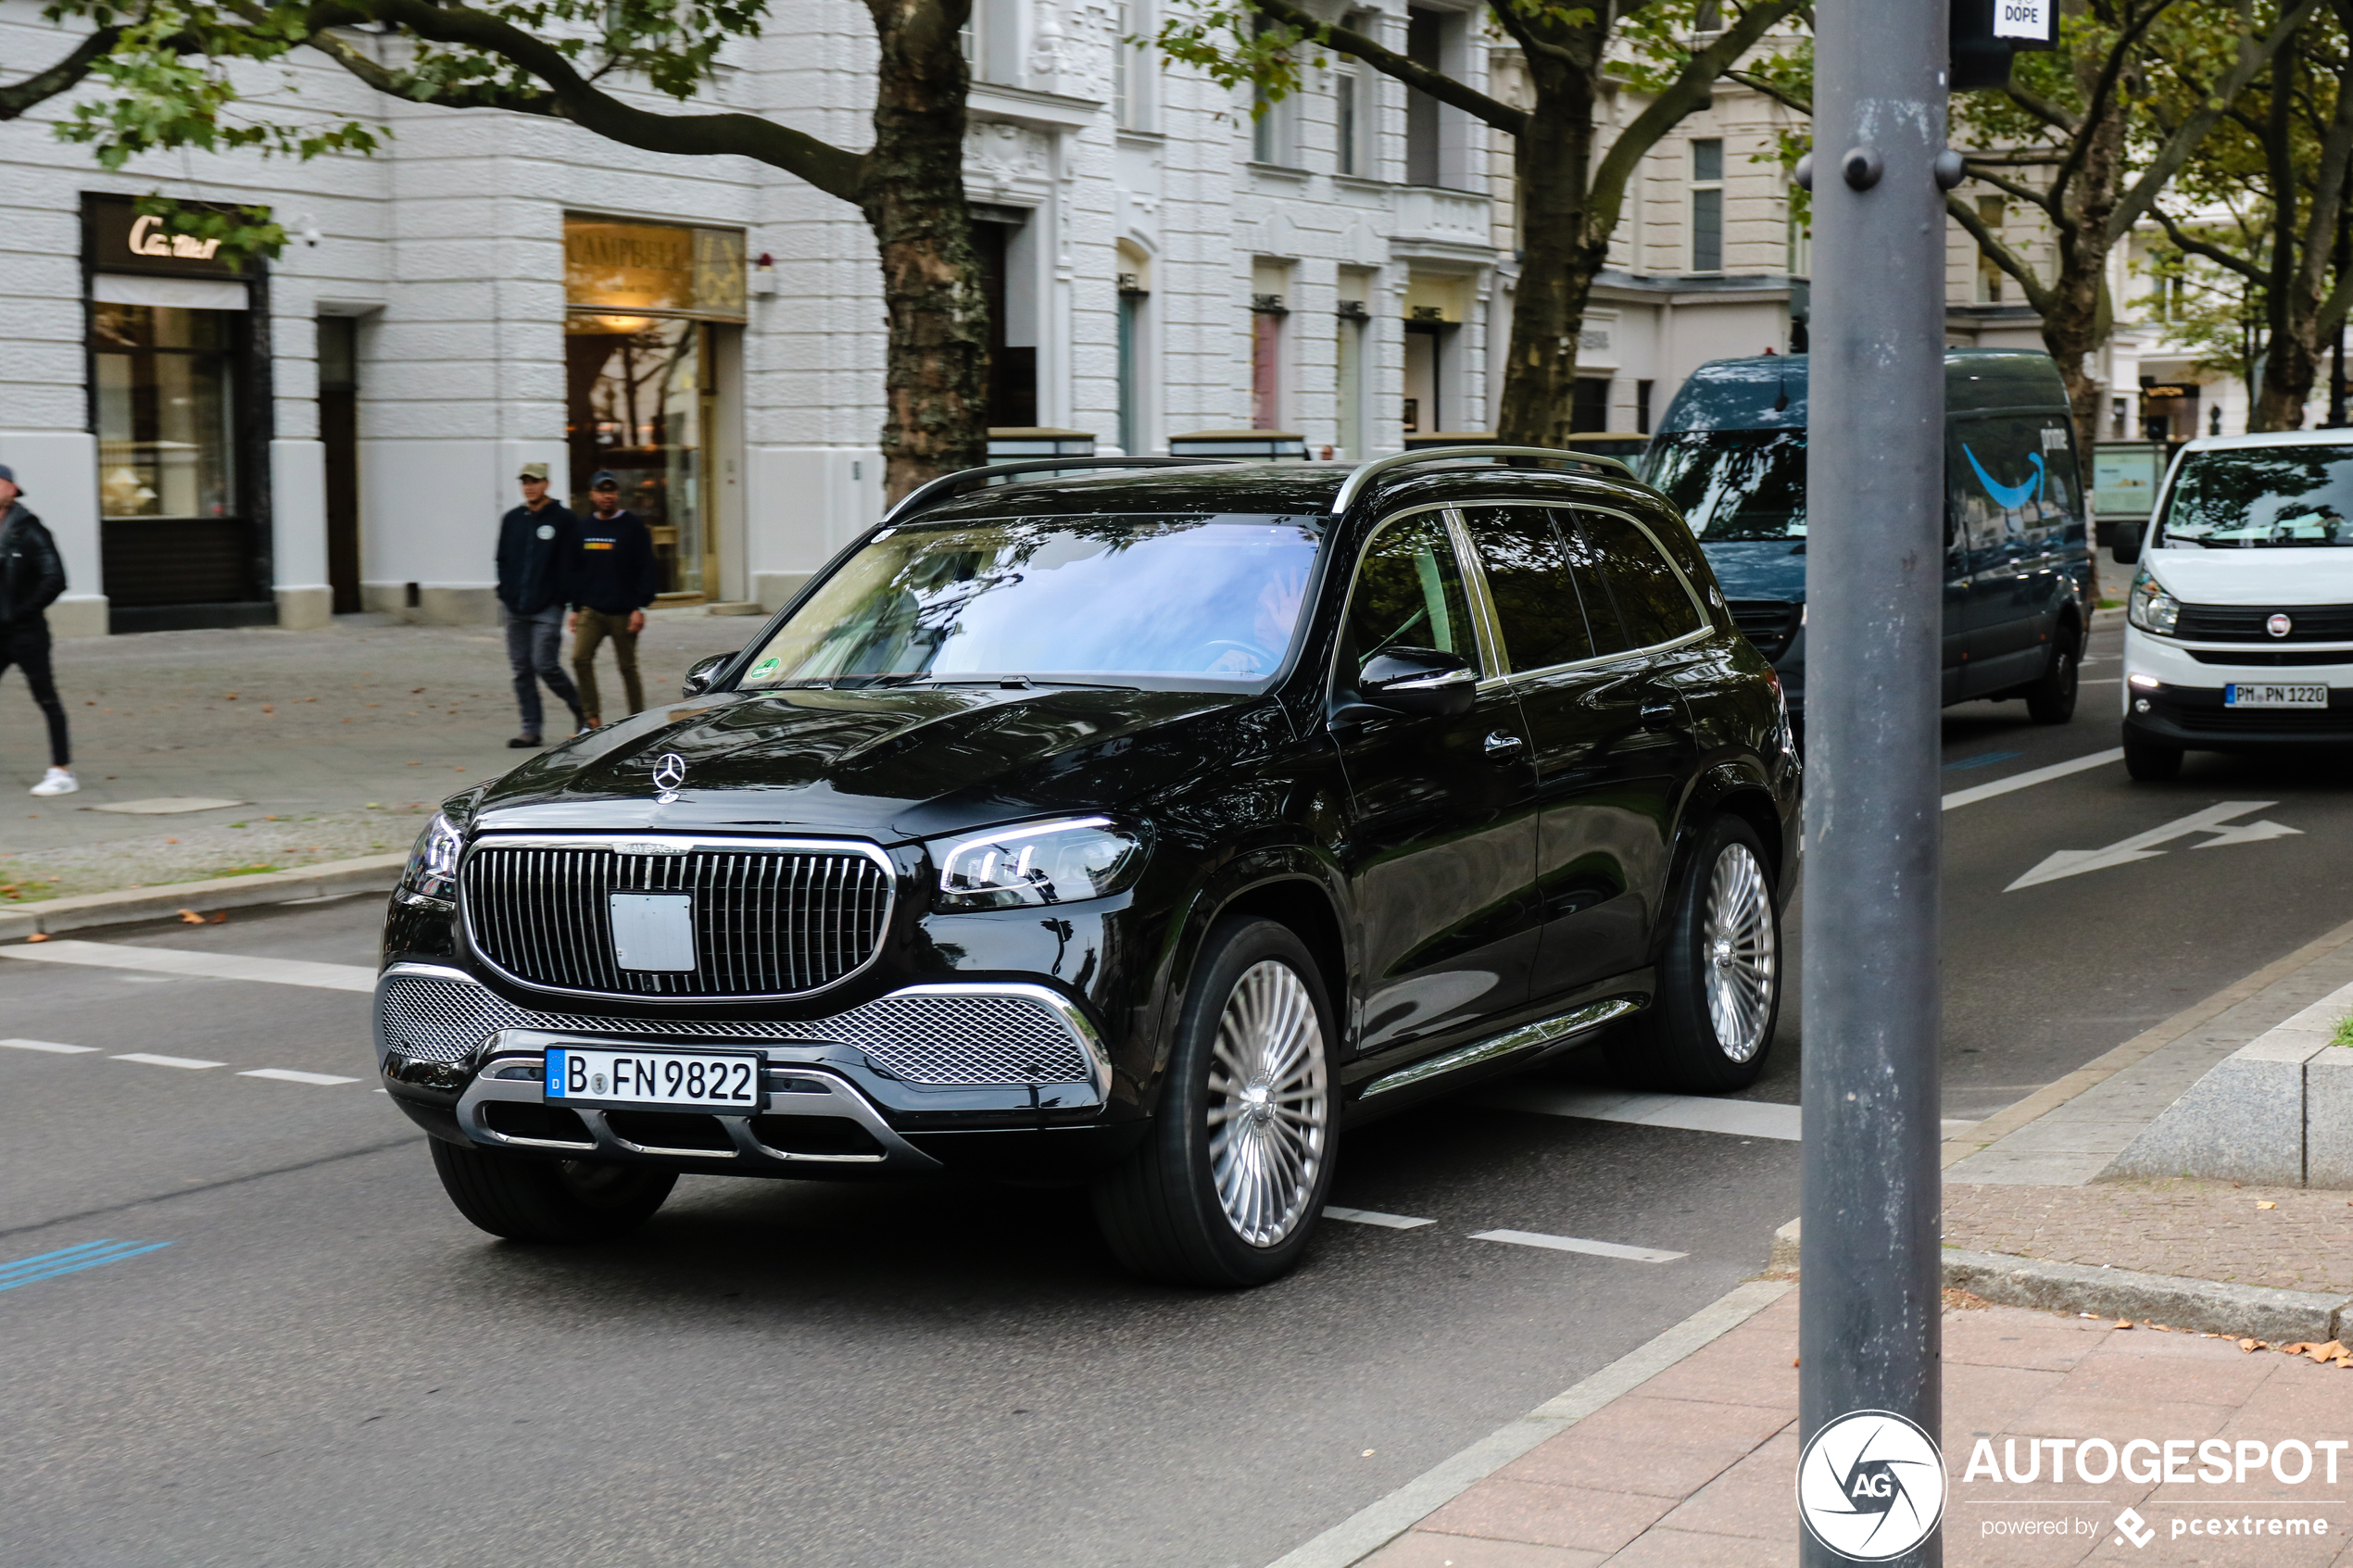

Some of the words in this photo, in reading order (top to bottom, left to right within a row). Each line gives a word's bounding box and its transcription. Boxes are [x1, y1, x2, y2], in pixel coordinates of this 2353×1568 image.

[2006, 6, 2038, 23] DOPE
[2040, 420, 2069, 458] prime
[2236, 687, 2254, 701] PM
[2266, 687, 2284, 702] PN
[2288, 687, 2324, 702] 1220
[620, 843, 681, 854] MAYBACH
[569, 1056, 587, 1092] B
[613, 1059, 656, 1097] FN
[665, 1060, 751, 1100] 9822
